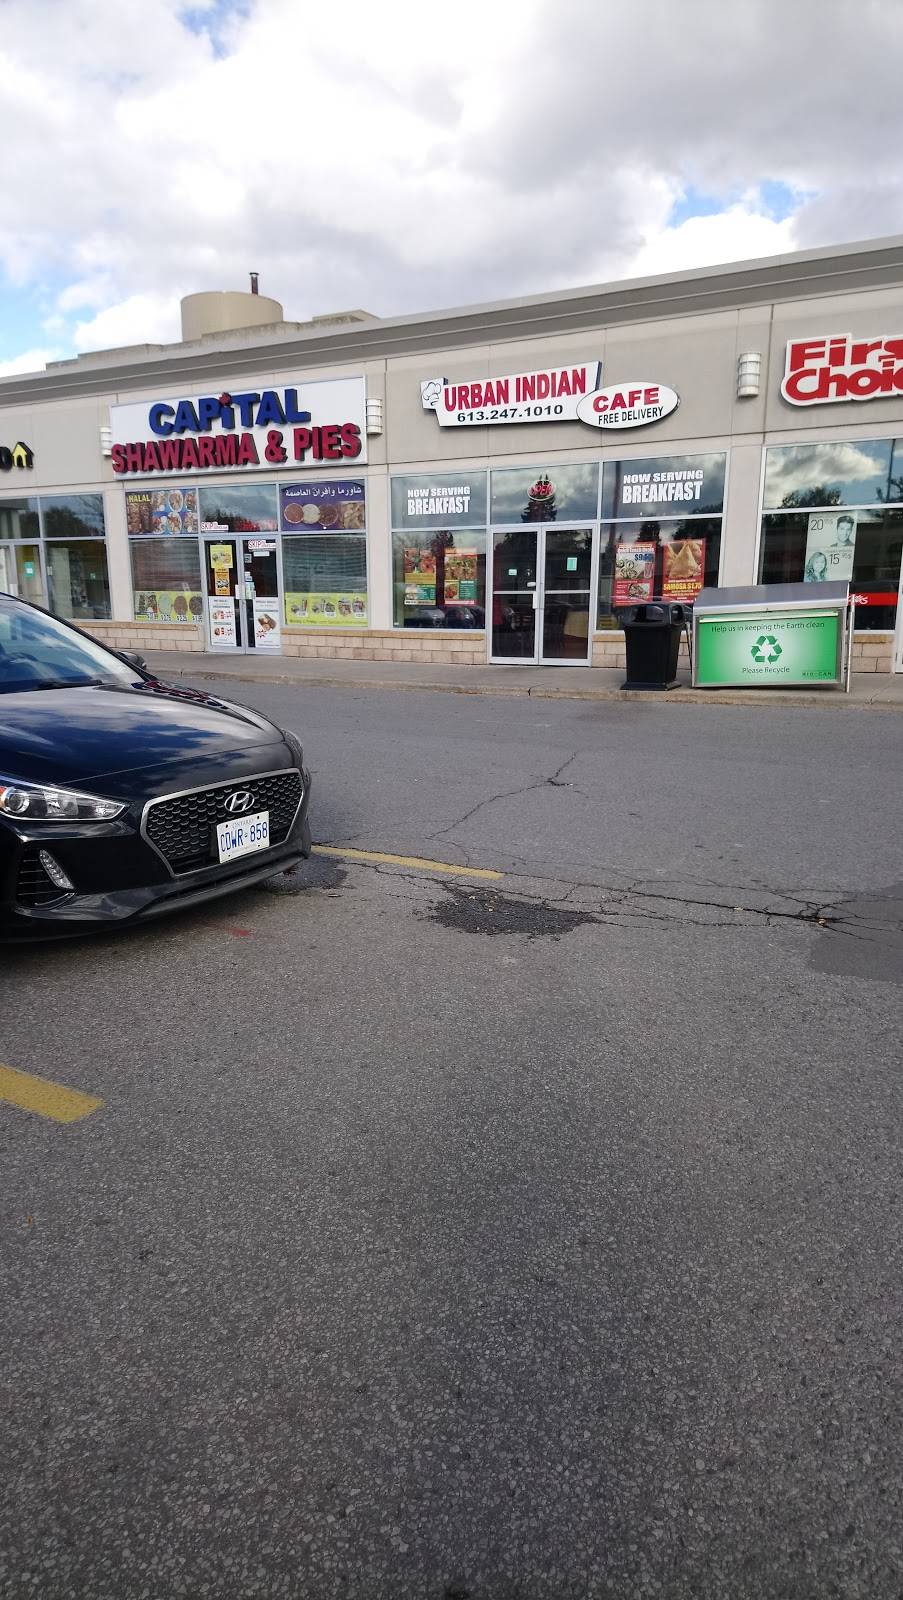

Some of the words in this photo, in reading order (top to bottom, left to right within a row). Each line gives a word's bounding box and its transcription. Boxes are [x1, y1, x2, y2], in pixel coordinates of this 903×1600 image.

[443, 377, 510, 412] URBAN
[515, 367, 587, 404] INDIAN
[592, 387, 660, 413] CAFE
[457, 404, 563, 422] 613.247.1010
[598, 413, 620, 425] FREE
[621, 406, 664, 422] DELIVERY
[111, 432, 261, 474] SHAWARMA
[264, 430, 289, 463] &
[293, 422, 362, 462] PIES
[623, 473, 652, 484] NOW
[652, 469, 704, 482] SERVING
[128, 494, 151, 503] HALAL
[407, 488, 430, 498] NOW
[430, 486, 471, 497] SERVING
[622, 480, 703, 504] BREAKFAST
[407, 495, 471, 516] BREAKFAST
[810, 518, 824, 531] 20
[830, 553, 840, 565] 15
[711, 625, 727, 633] Help
[745, 623, 772, 632] keeping
[773, 622, 785, 630] the
[806, 621, 825, 629] clean
[742, 666, 763, 674] Please
[763, 666, 790, 675] Recycle
[249, 821, 268, 842] 858
